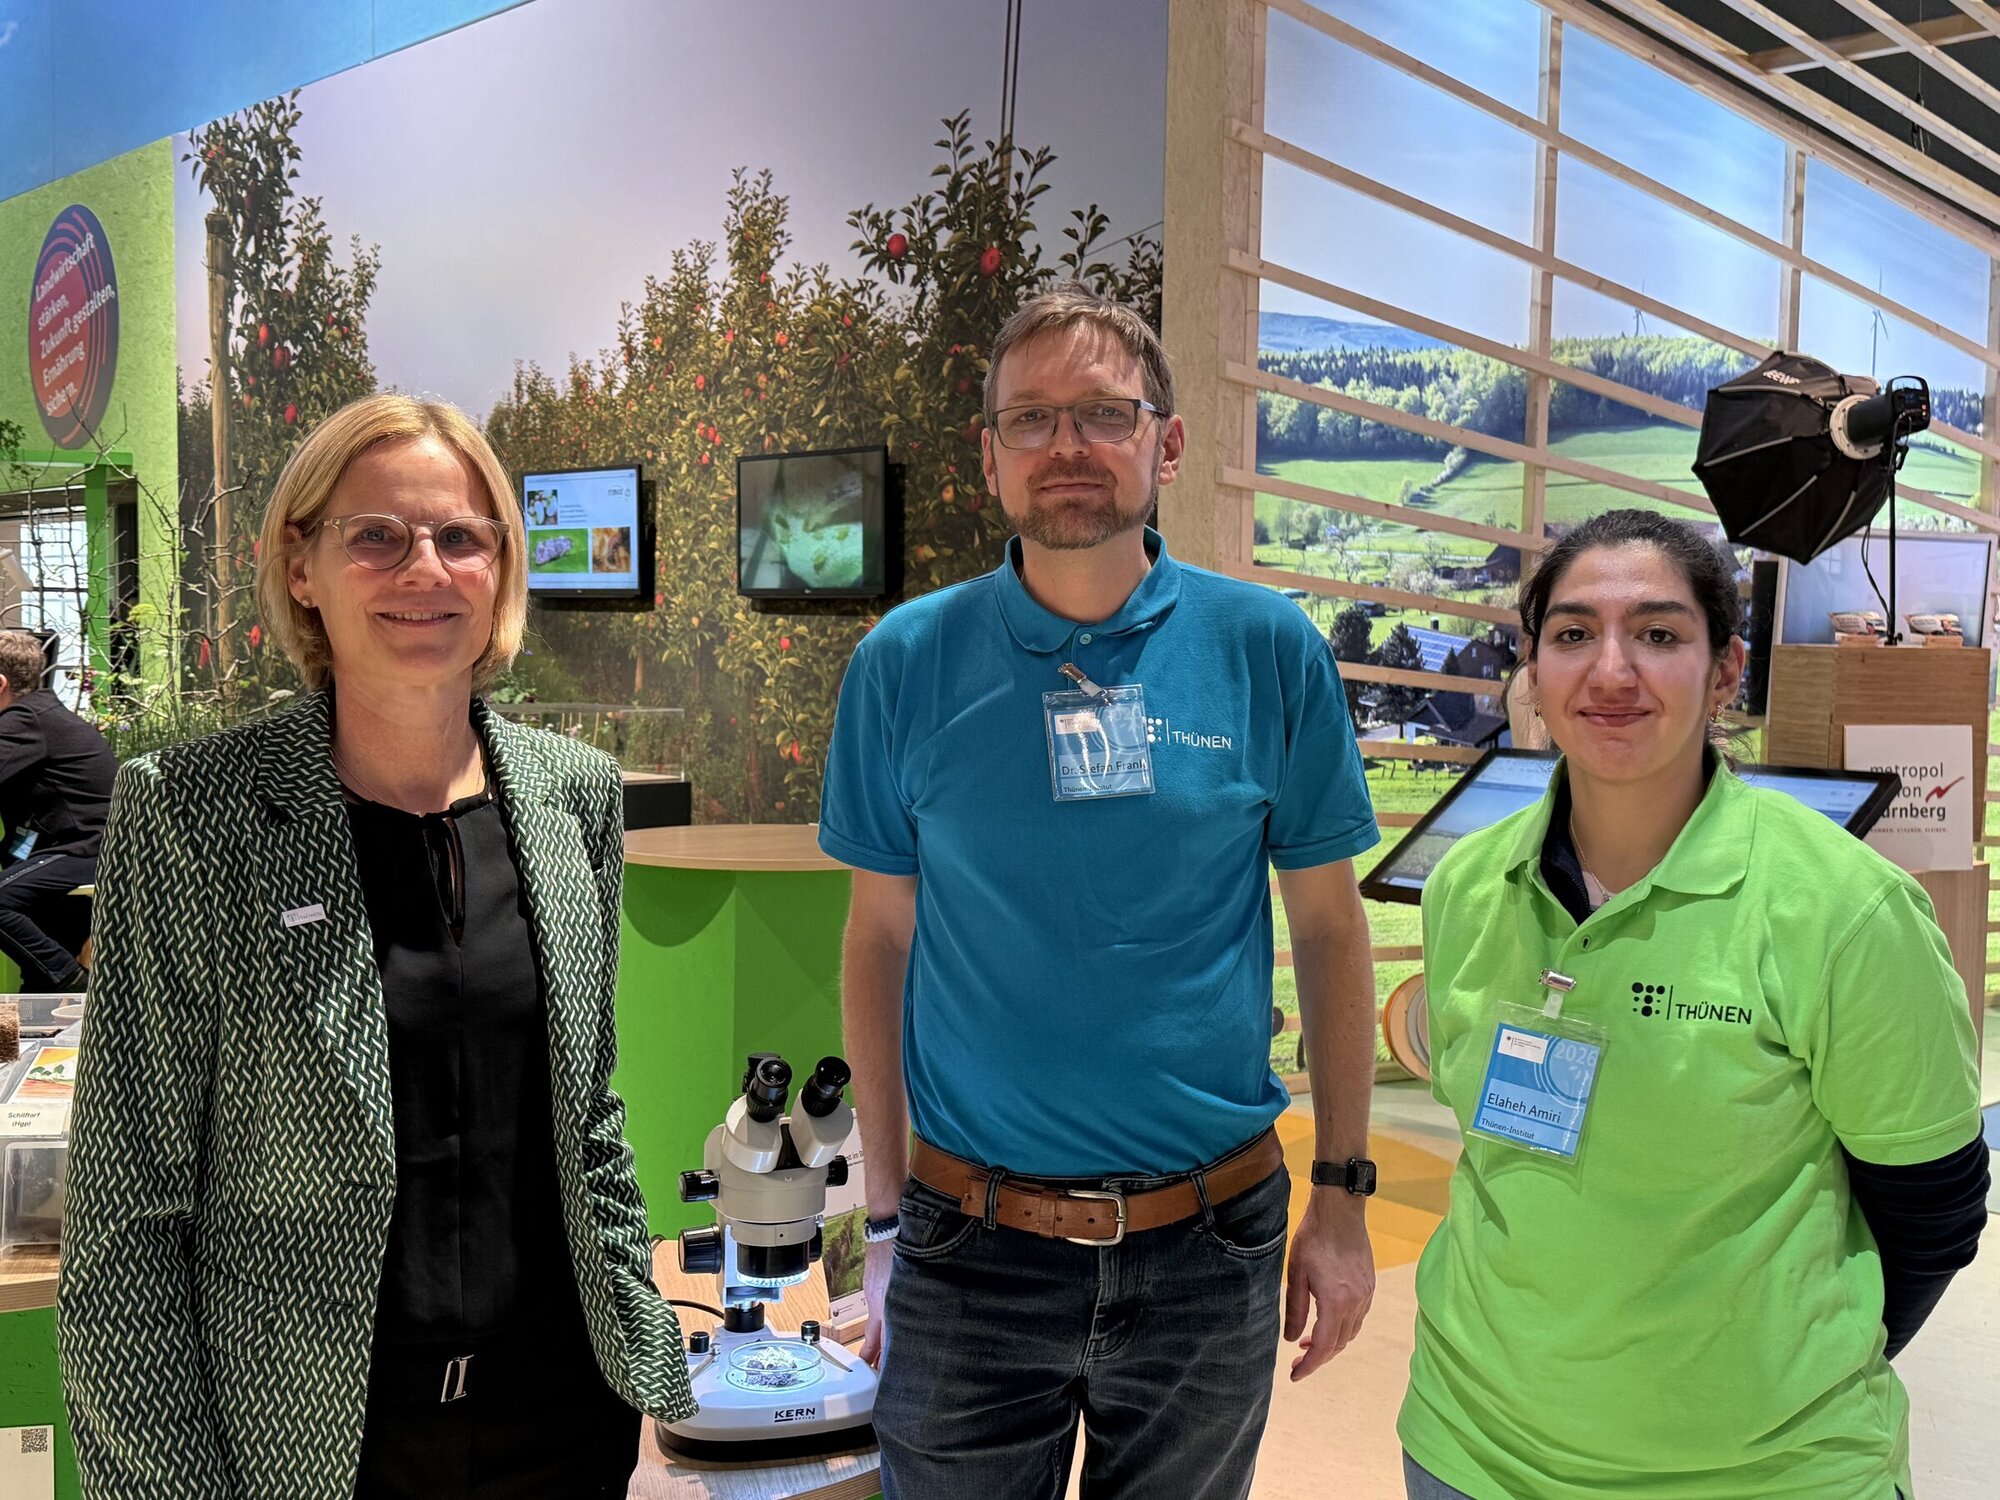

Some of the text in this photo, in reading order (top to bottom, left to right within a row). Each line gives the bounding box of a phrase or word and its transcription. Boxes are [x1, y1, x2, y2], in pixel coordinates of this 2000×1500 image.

[35, 232, 95, 302] Landwirtschaft
[40, 282, 115, 359] Zukunft gestalten,
[43, 341, 85, 387] Ernährung
[1172, 730, 1232, 749] THÜNEN
[1062, 765, 1077, 775] Dr.
[1080, 761, 1112, 774] Sefan
[1882, 803, 1946, 821] rnberg
[1675, 1001, 1752, 1024] THÜNEN
[1554, 1042, 1598, 1066] 2026
[1487, 1093, 1561, 1123] Elaheh Amiri
[1481, 1117, 1535, 1139] Thünen-Institut
[774, 1407, 815, 1419] KERN
